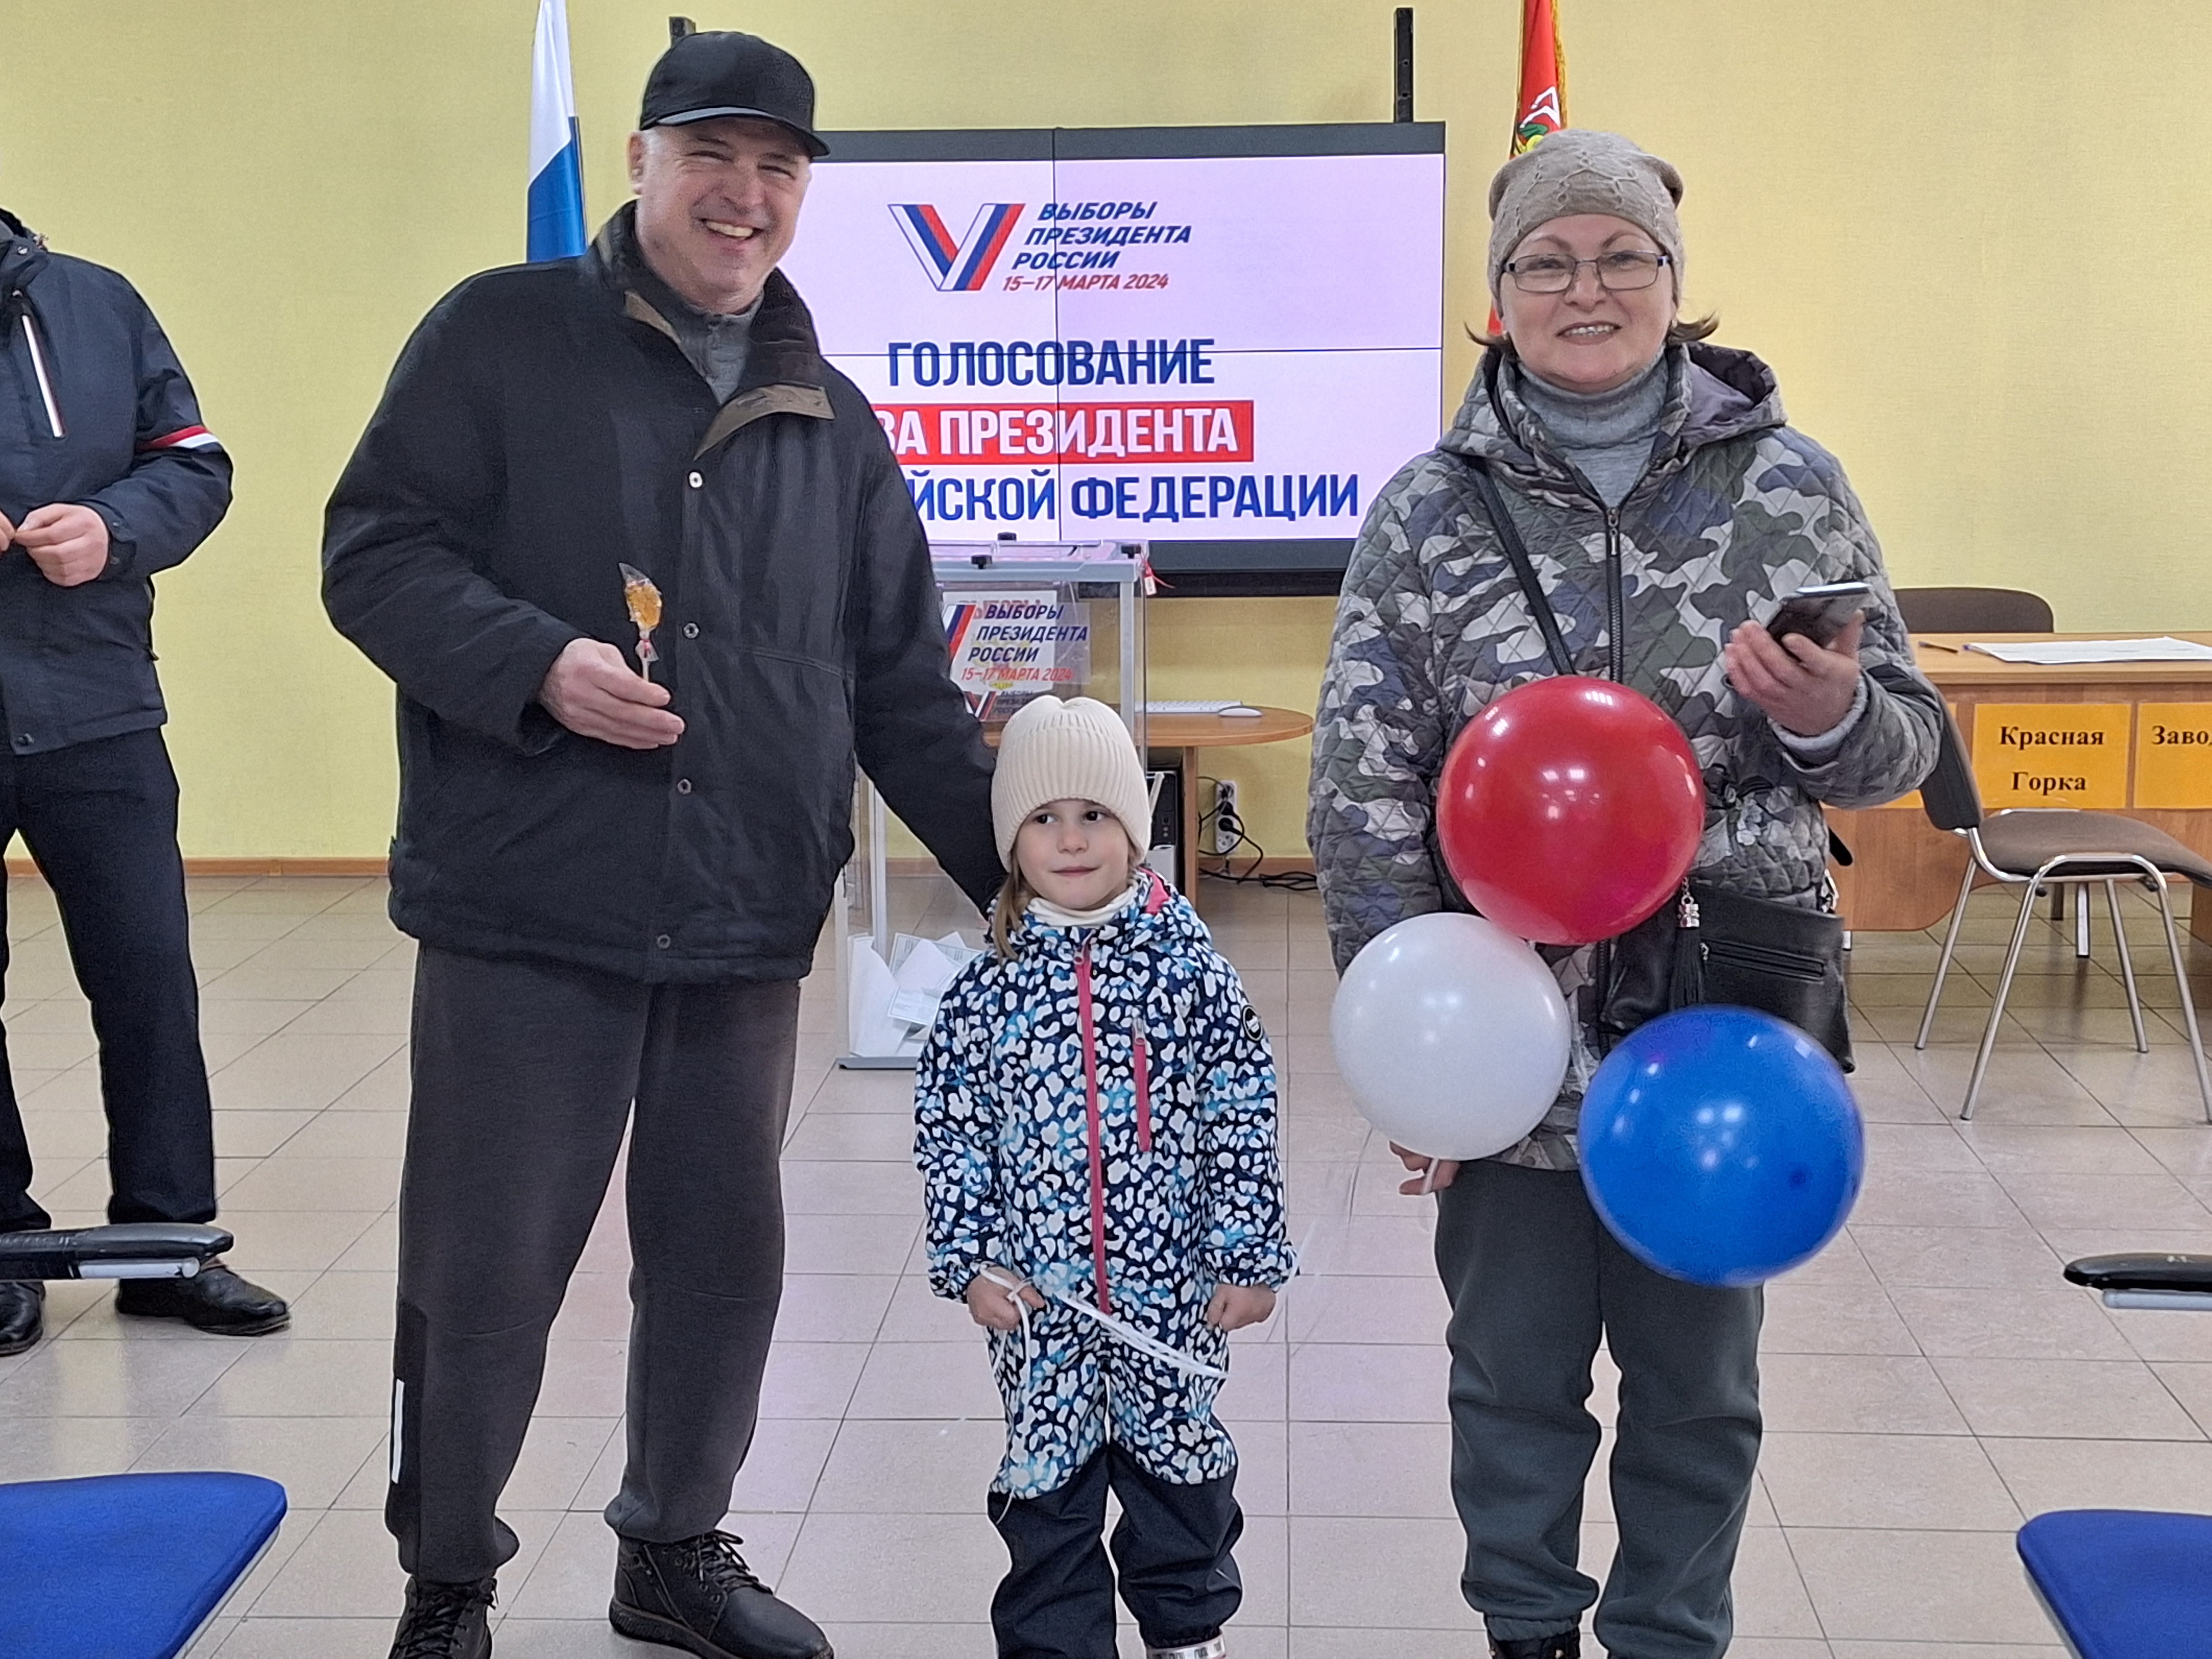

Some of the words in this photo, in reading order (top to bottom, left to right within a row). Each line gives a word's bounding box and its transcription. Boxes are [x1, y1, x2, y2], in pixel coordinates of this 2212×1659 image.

[1037, 201, 1158, 221] ВЫБОРЫ
[1024, 225, 1192, 247] ПРЕЗИДЕНТА
[1011, 250, 1121, 270] РОССИИ
[1057, 274, 1122, 291] МАРТА
[1123, 273, 1169, 290] 2024
[888, 339, 1214, 386] ГОЛОСОВАНИЕ
[940, 409, 1238, 458] ПРЕЗИДЕНТА
[906, 470, 1056, 520] ЙСКОЙ
[1071, 474, 1358, 523] ФЕДЕРАЦИИ
[984, 604, 1064, 620] ВЫБОРЫ
[976, 626, 1088, 644] ПРЕЗИДЕНТА
[968, 647, 1040, 663] РОССИИ
[995, 667, 1040, 680] МАРТА
[1041, 667, 1075, 681] 2024
[2000, 726, 2104, 751] Красная
[2150, 725, 2212, 747] Заво
[2011, 771, 2086, 796] Горка
